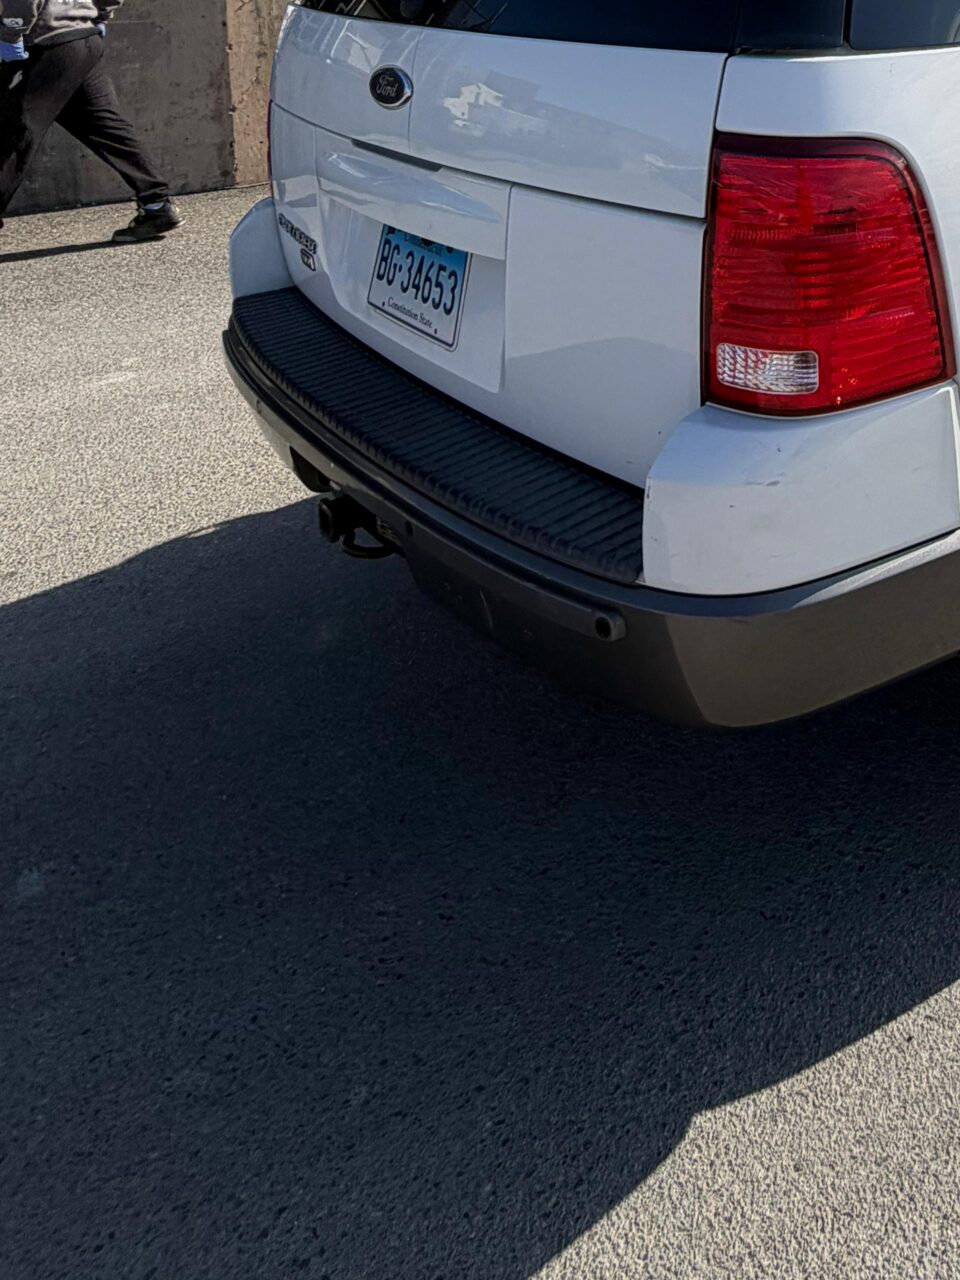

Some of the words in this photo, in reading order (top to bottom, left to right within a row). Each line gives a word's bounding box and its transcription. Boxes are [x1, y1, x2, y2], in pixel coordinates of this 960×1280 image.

[376, 74, 399, 97] Ford
[387, 297, 418, 321] Constitution
[420, 313, 432, 328] State
